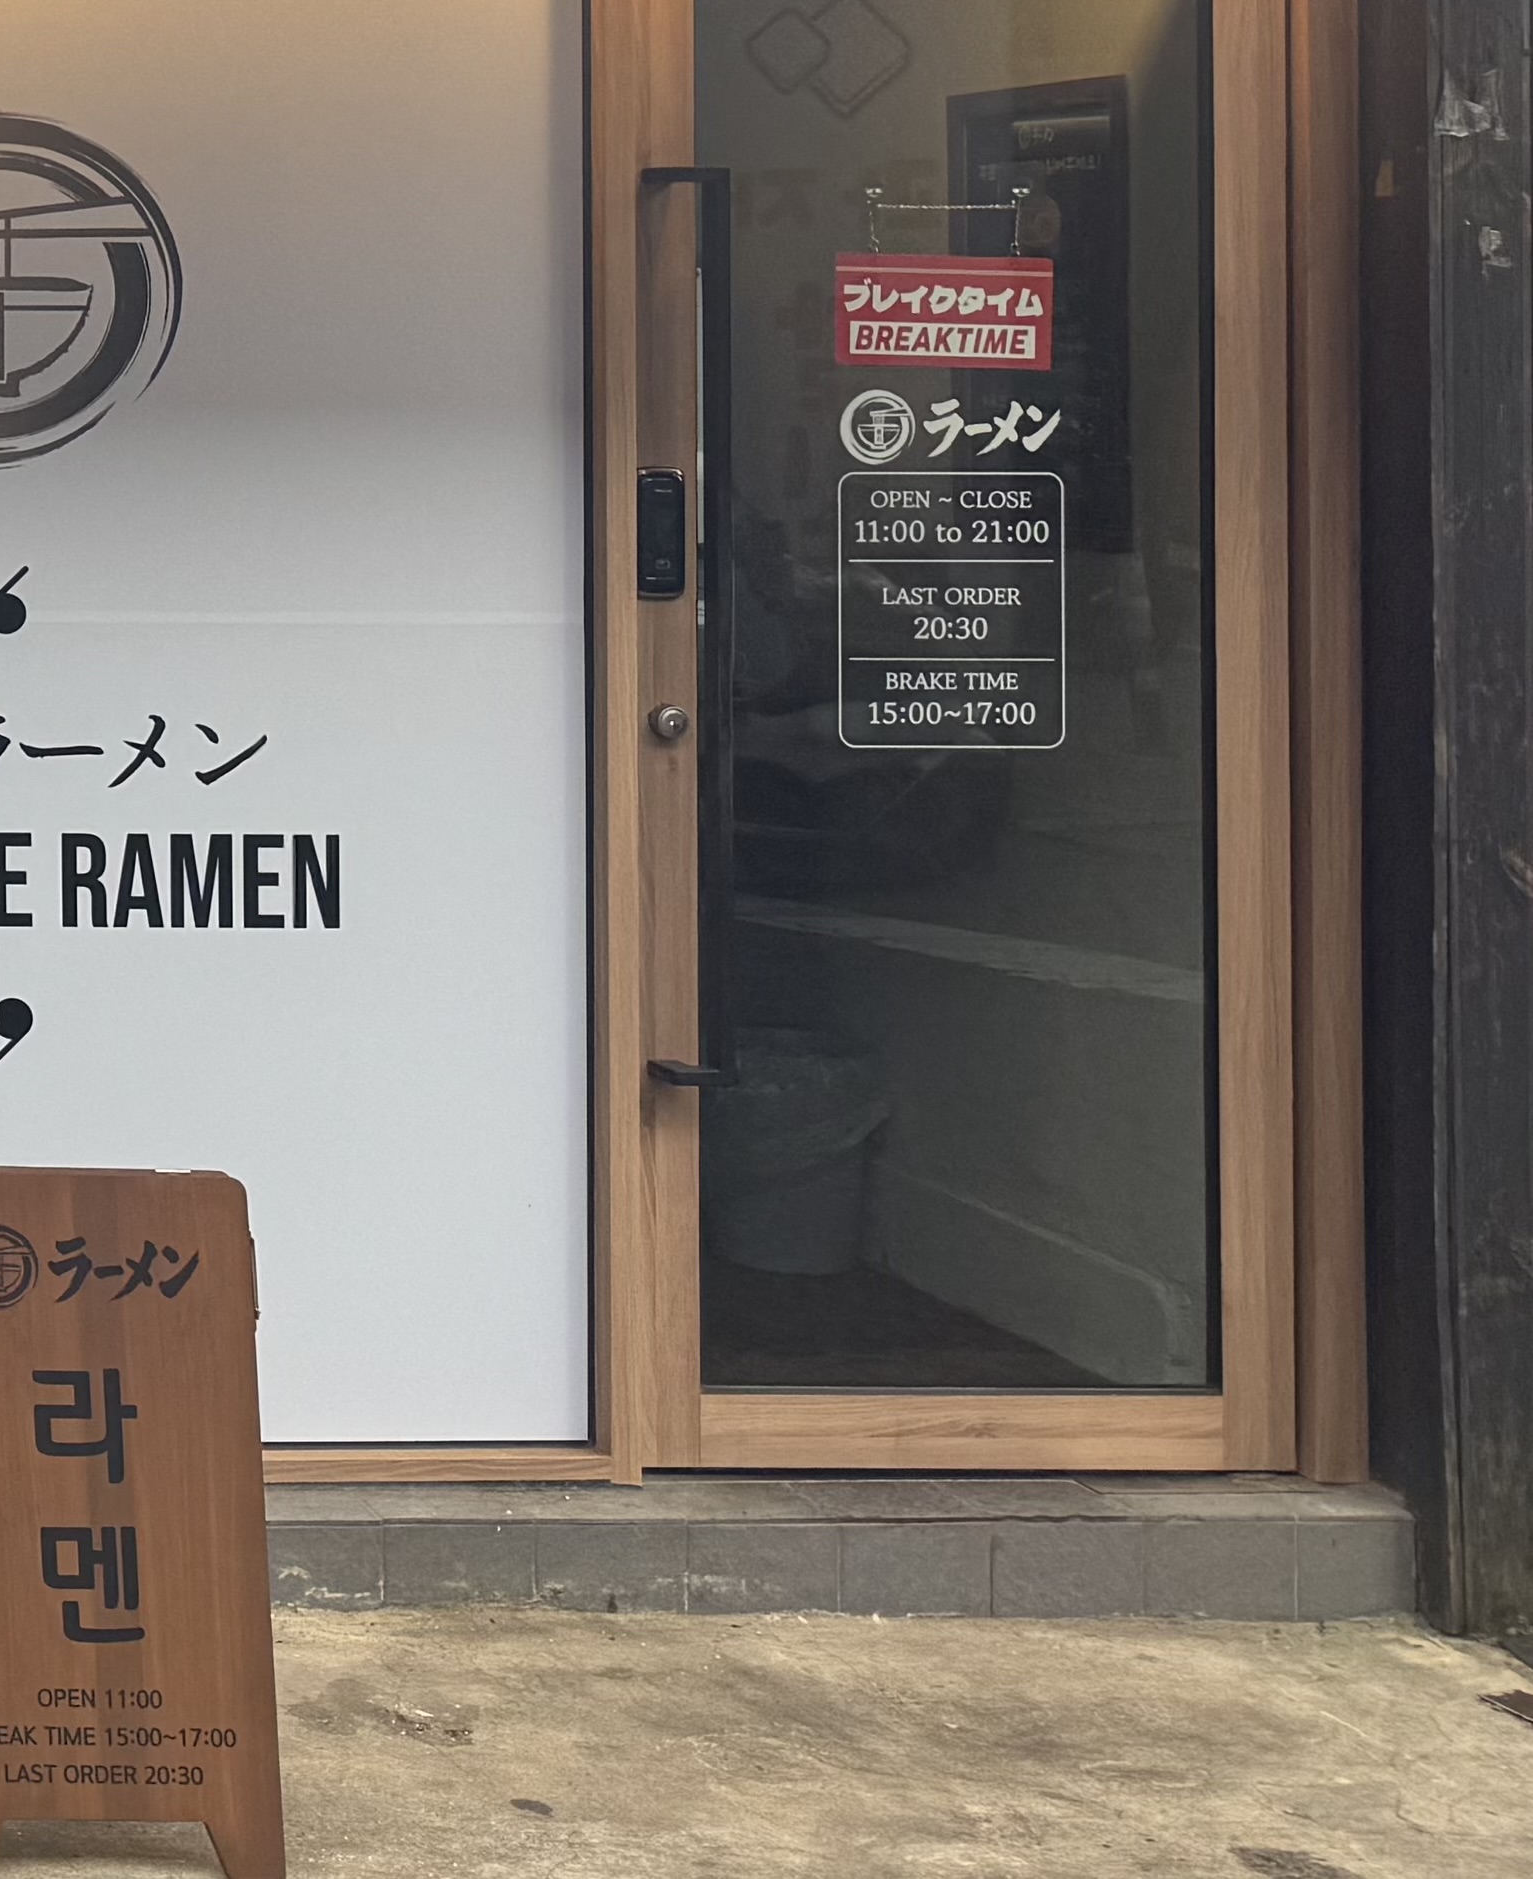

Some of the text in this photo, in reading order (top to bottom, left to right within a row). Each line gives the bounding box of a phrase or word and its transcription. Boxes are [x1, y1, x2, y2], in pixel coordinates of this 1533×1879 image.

[843, 277, 1044, 318] ブレイクタイム
[855, 323, 1029, 355] BREAKTIME
[923, 398, 1061, 458] ラーメン
[870, 490, 931, 509] OPEN
[959, 490, 1032, 509] CLOSE
[854, 520, 1050, 544] 11:00 to 21:00
[882, 587, 1021, 606] LAST ORDER
[913, 616, 988, 641] 20:30
[885, 672, 1018, 691] BRAKE TIME
[868, 701, 1036, 726] 15:00~17:00
[61, 832, 341, 930] RAMEN
[47, 1237, 199, 1303] ラーメン
[32, 1368, 145, 1643] 라멘
[37, 1689, 163, 1710] OPEN 11:00
[43, 1725, 96, 1747] TIME
[104, 1726, 237, 1749] 15:00~17:00
[4, 1763, 204, 1787] LAST ORDER 20:30
